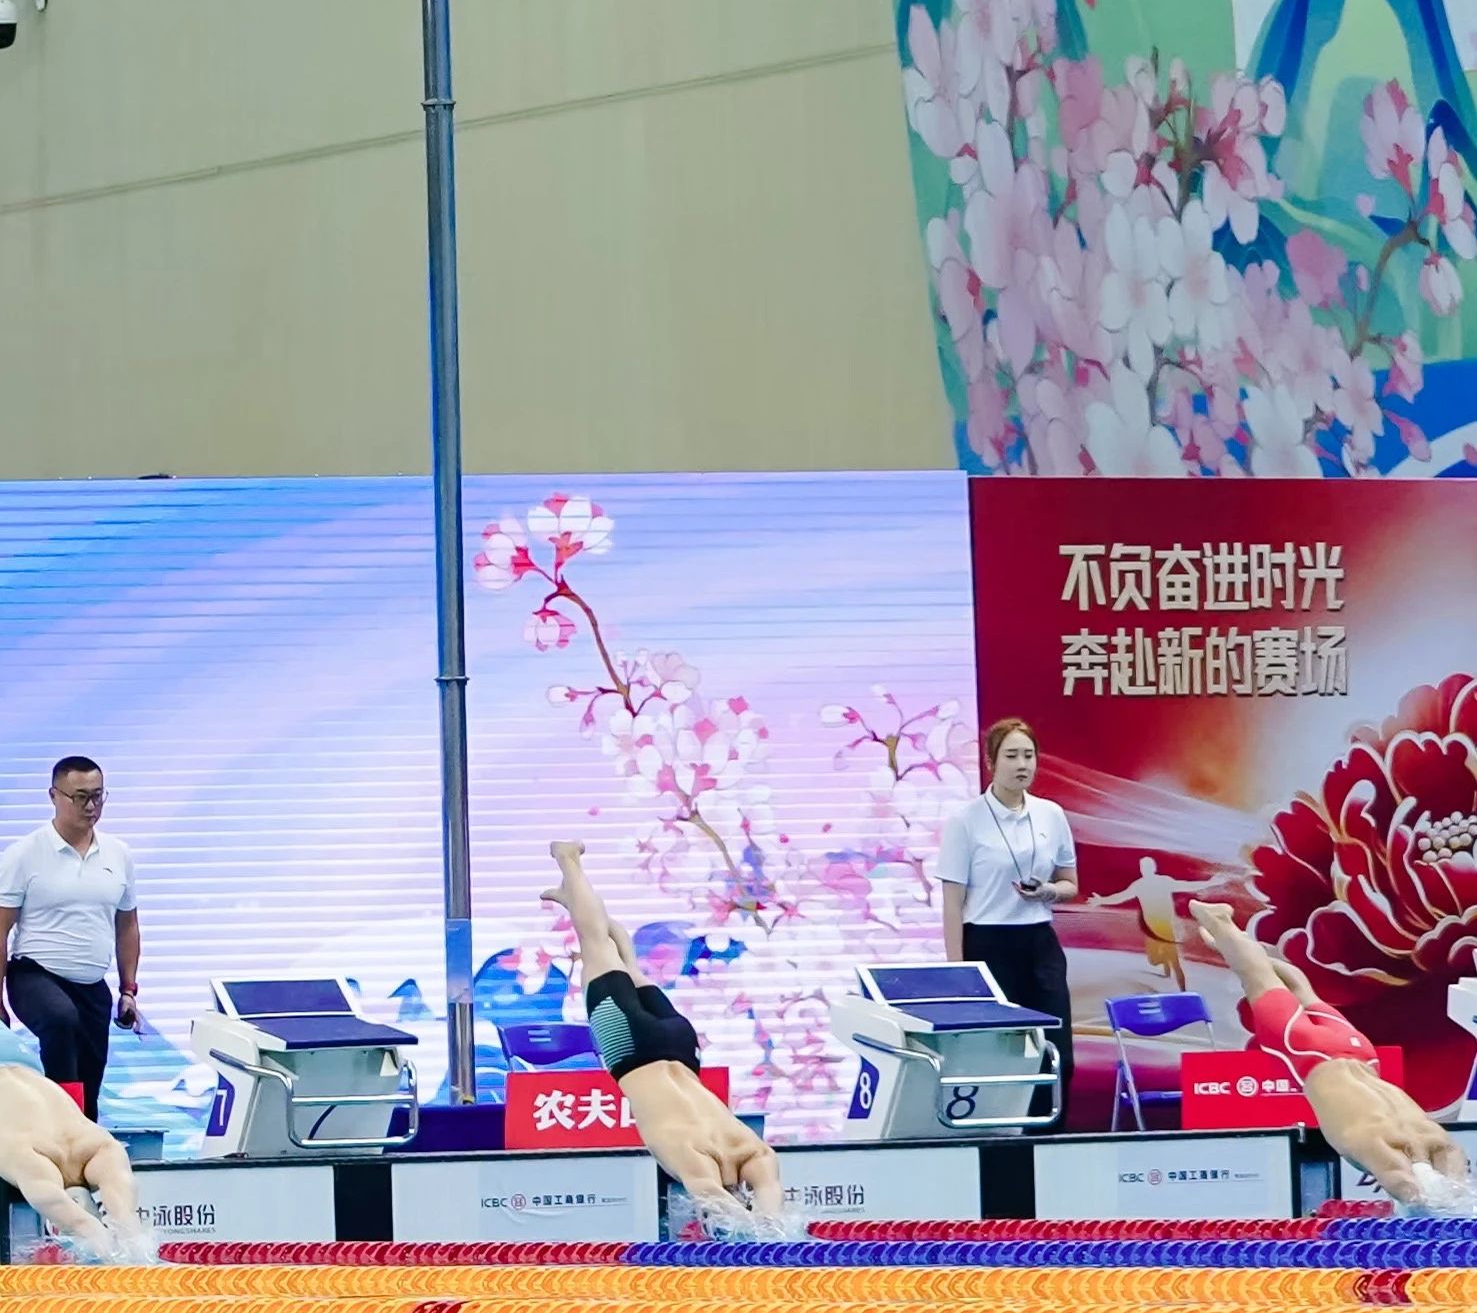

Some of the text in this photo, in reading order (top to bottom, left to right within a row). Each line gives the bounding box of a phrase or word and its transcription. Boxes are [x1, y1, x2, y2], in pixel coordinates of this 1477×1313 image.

[1058, 542, 1345, 613] 不负奋进时光
[1061, 625, 1350, 697] 奔赴新的赛场
[859, 1072, 870, 1109] 8
[945, 1081, 979, 1121] 8
[1194, 1081, 1231, 1096] ICBC
[1262, 1078, 1298, 1093] 中国
[216, 1088, 228, 1127] 7
[481, 1197, 508, 1209] ICBC
[531, 1193, 597, 1207] 中国工商银行
